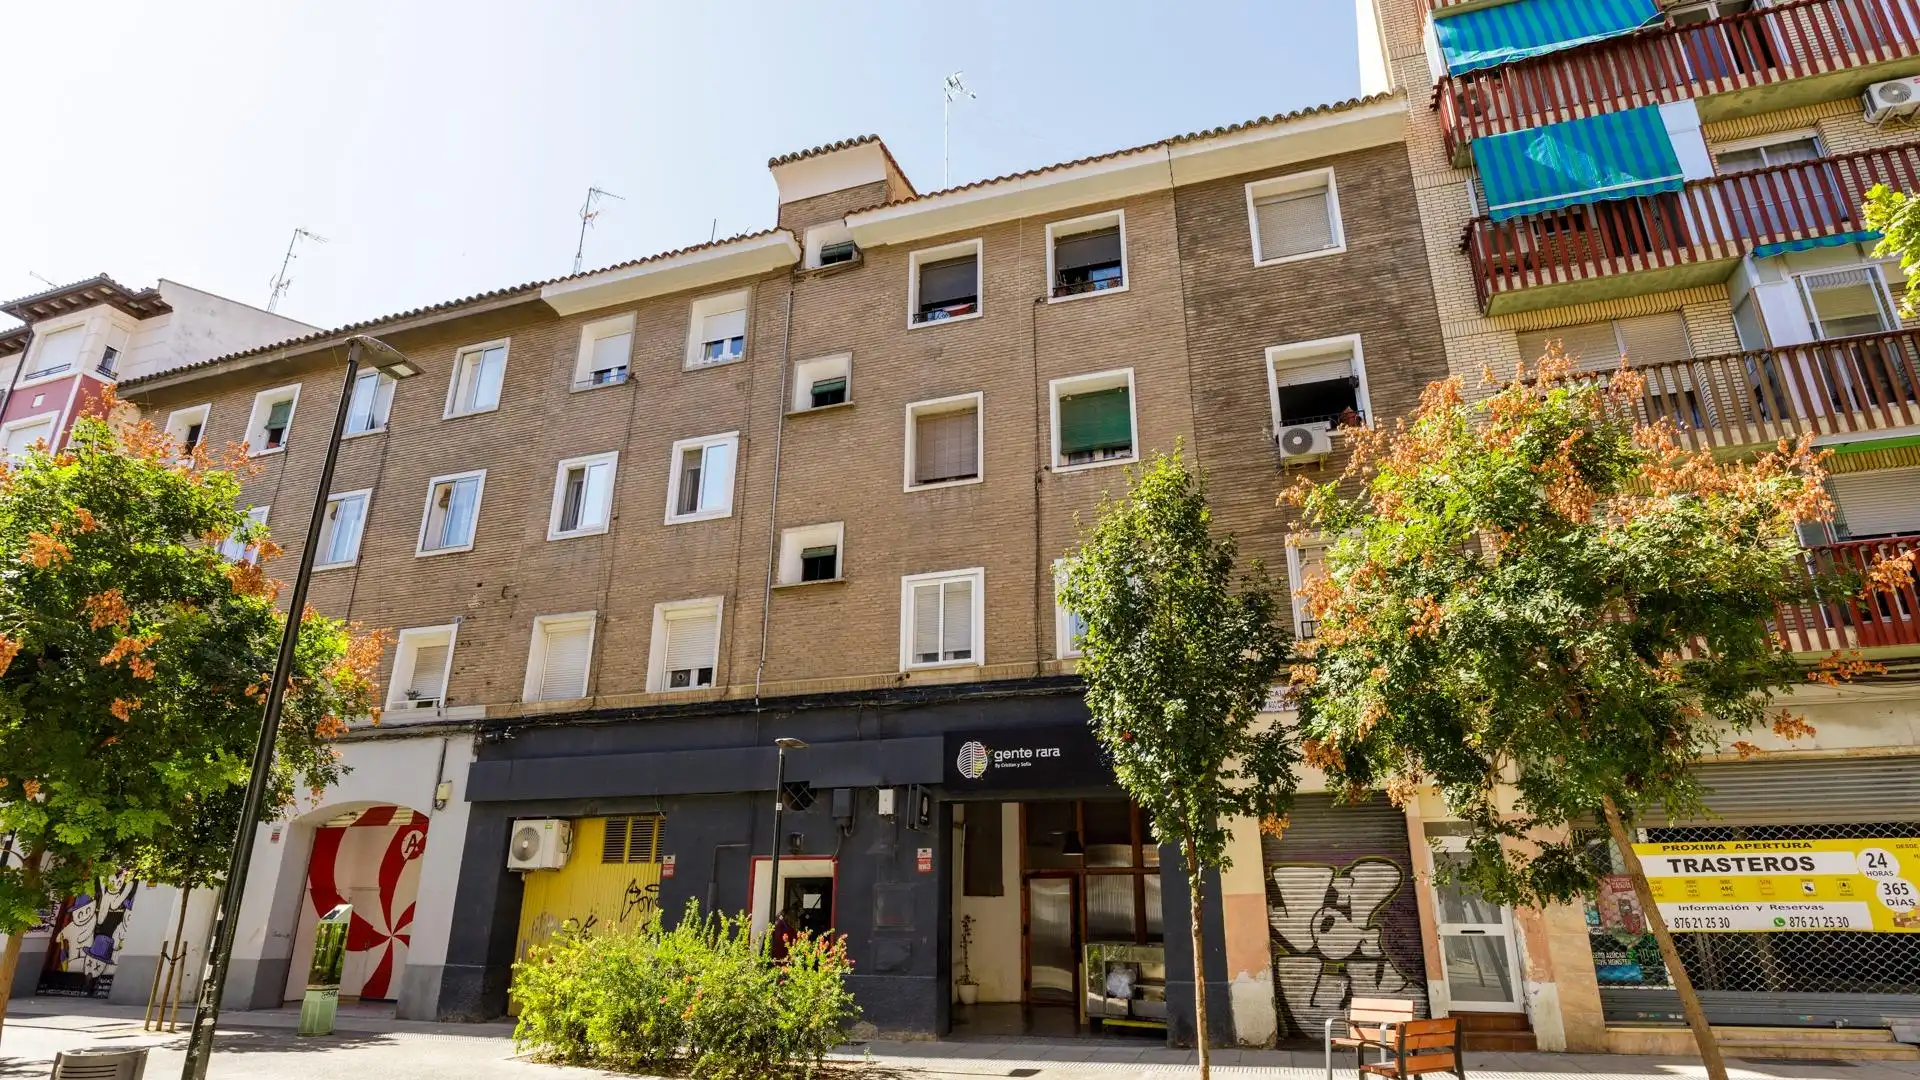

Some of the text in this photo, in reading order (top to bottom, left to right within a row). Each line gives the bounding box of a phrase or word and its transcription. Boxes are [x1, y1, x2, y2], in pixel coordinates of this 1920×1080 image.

[994, 748, 1060, 762] gente rara
[1735, 842, 1813, 850] APERTURA
[1667, 856, 1815, 873] TRASTEROS
[1865, 852, 1888, 868] 24
[1883, 883, 1909, 896] 365
[1886, 898, 1916, 906] DÍAS
[1674, 917, 1730, 929] 876 21 25 30
[1789, 916, 1849, 928] 876 21 25 30
